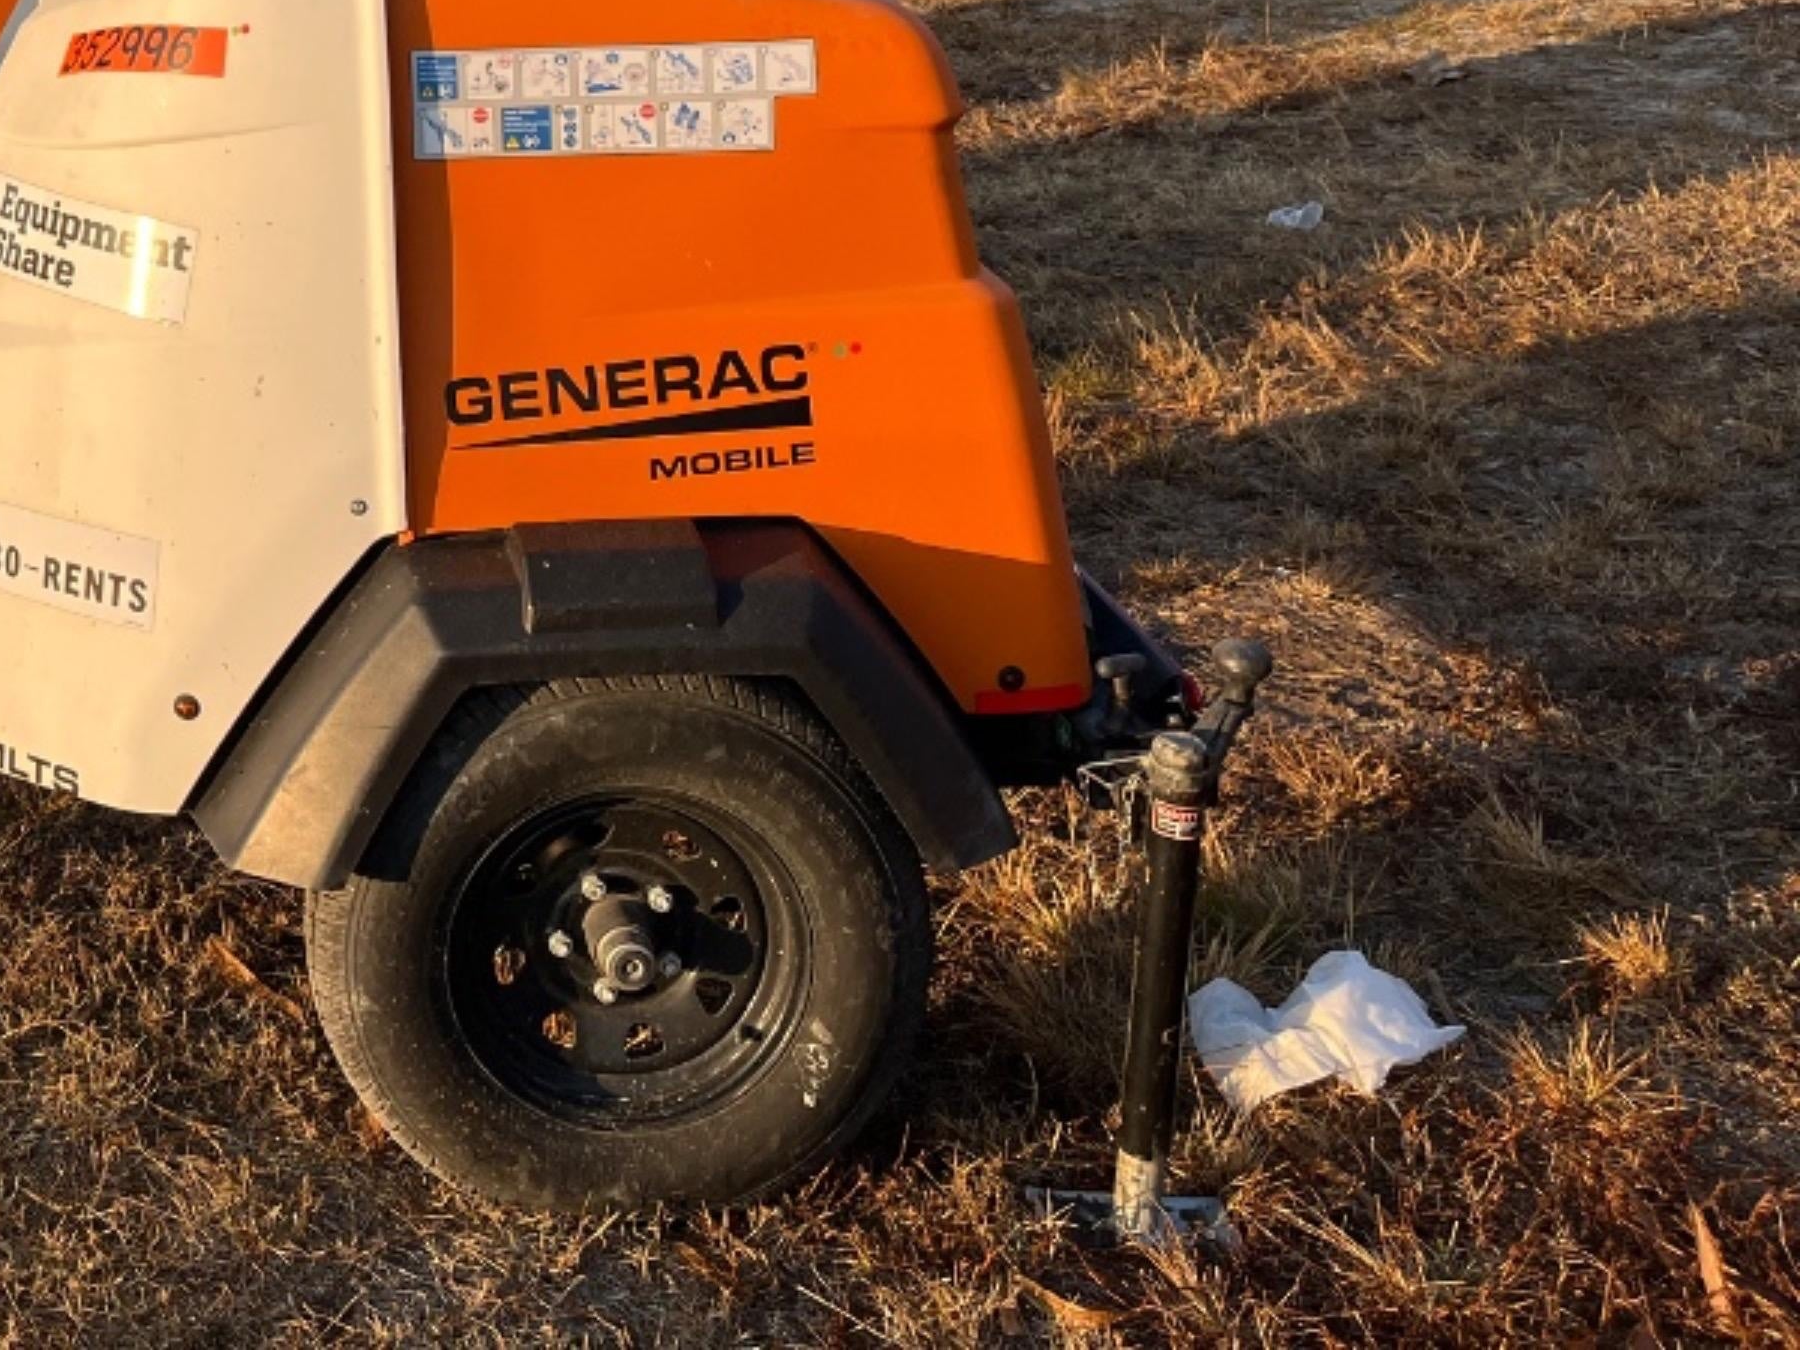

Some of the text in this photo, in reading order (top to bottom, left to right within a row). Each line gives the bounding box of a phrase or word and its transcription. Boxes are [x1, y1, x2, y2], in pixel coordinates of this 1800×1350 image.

[62, 25, 198, 73] 352996
[444, 344, 809, 426] GENERAC
[650, 442, 816, 481] MOBILE
